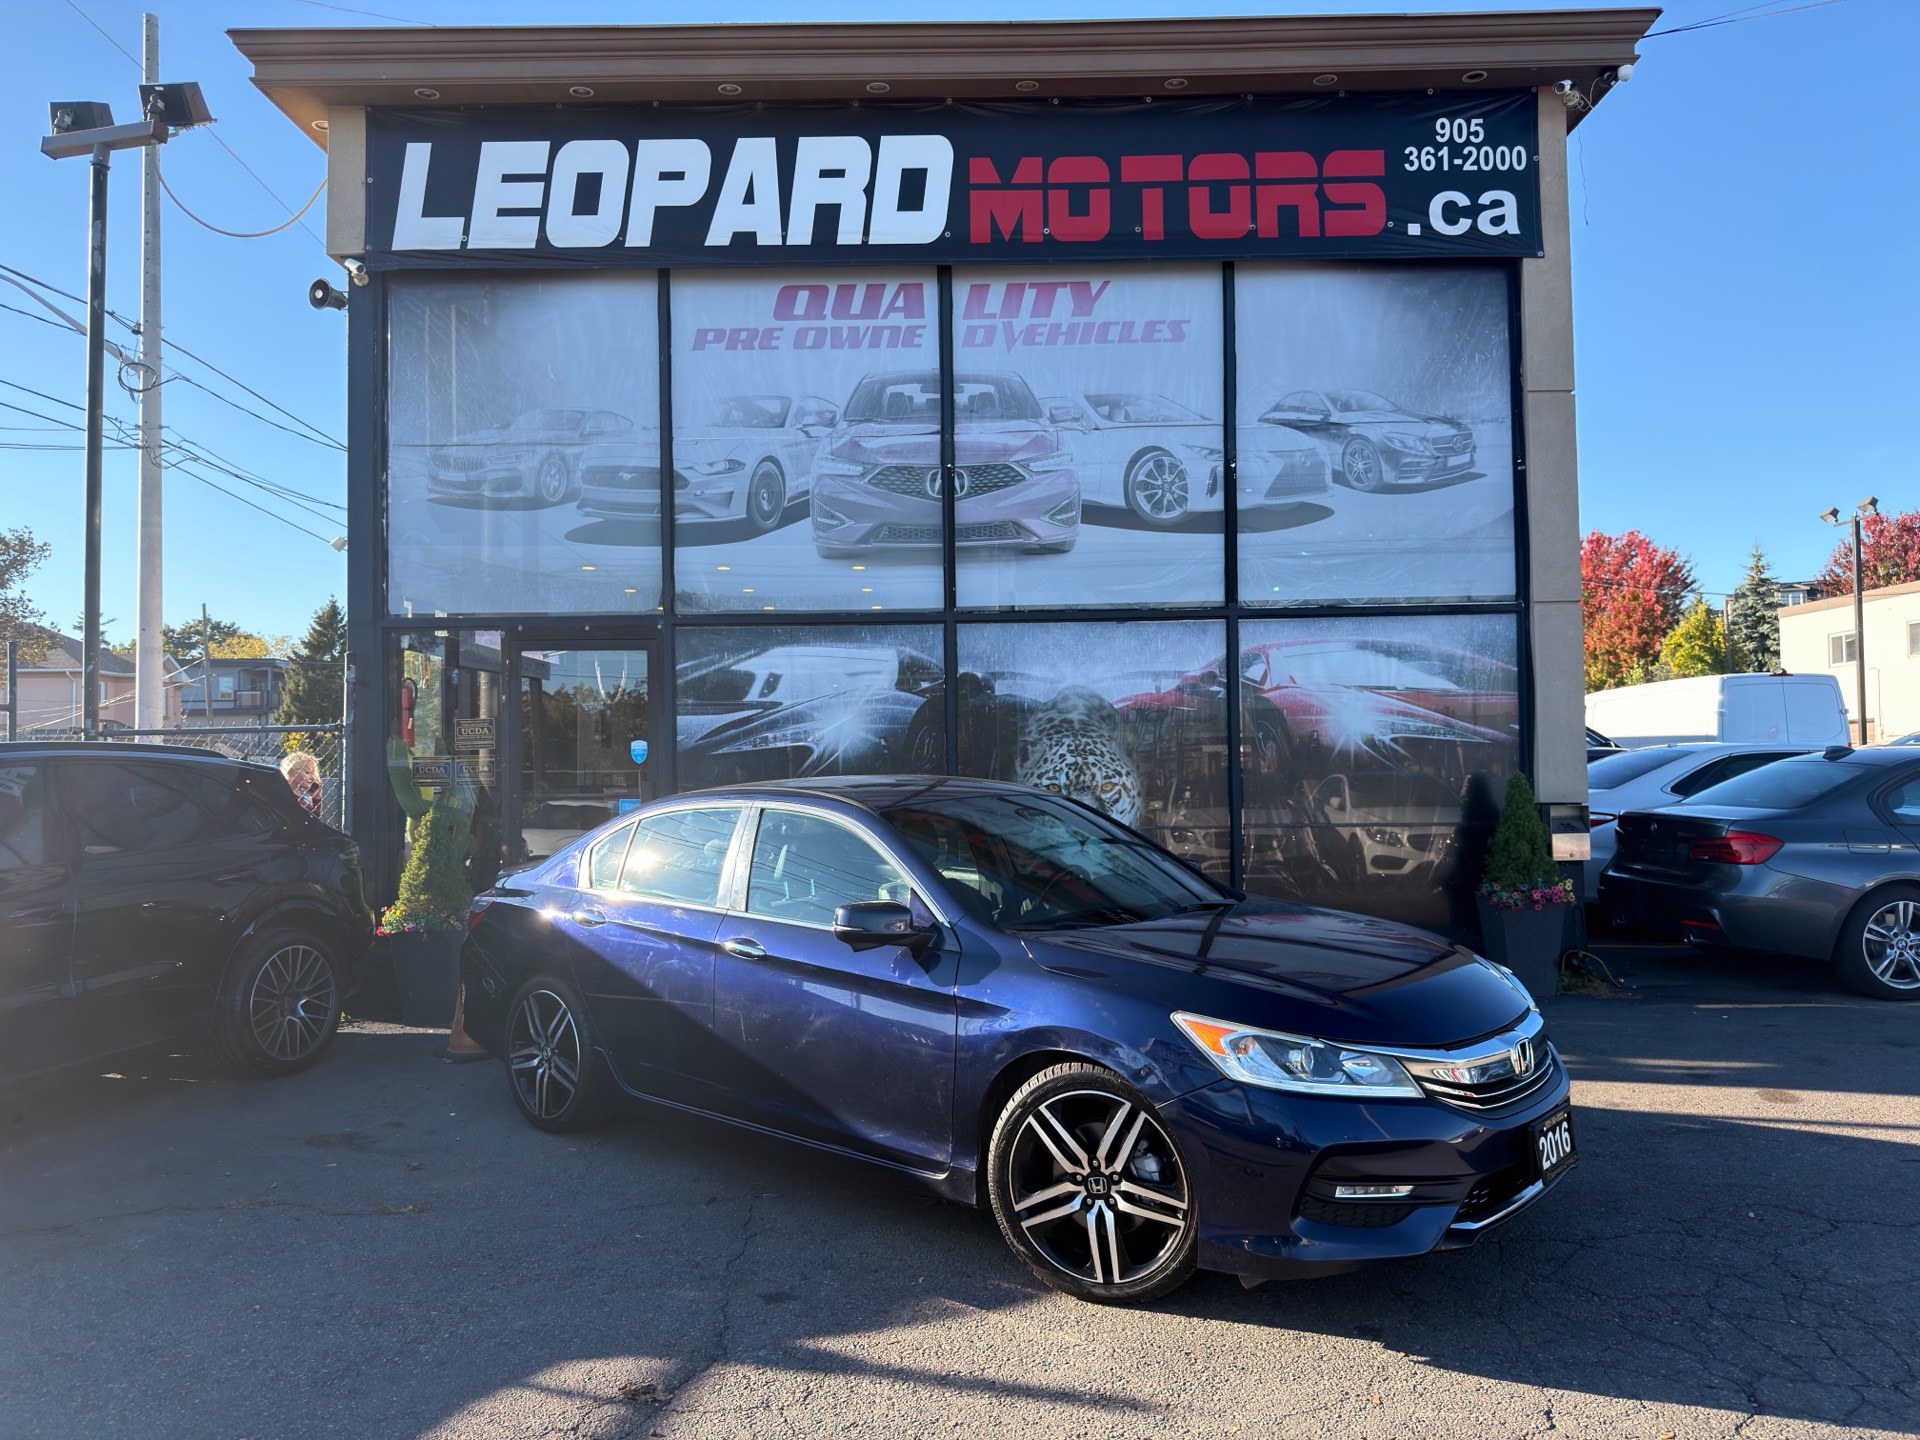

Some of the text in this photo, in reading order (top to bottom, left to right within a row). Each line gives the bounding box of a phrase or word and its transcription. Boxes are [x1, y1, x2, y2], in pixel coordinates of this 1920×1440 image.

[1434, 117, 1485, 144] 905
[1403, 145, 1527, 172] 361-2000
[391, 134, 1386, 251] LEOPARD MOTORS
[692, 327, 784, 351] PRE
[792, 325, 924, 349] OWNE
[461, 727, 489, 735] UCDA
[419, 766, 446, 774] UCDA
[462, 765, 489, 773] UCDA
[1539, 1121, 1571, 1171] 2016
